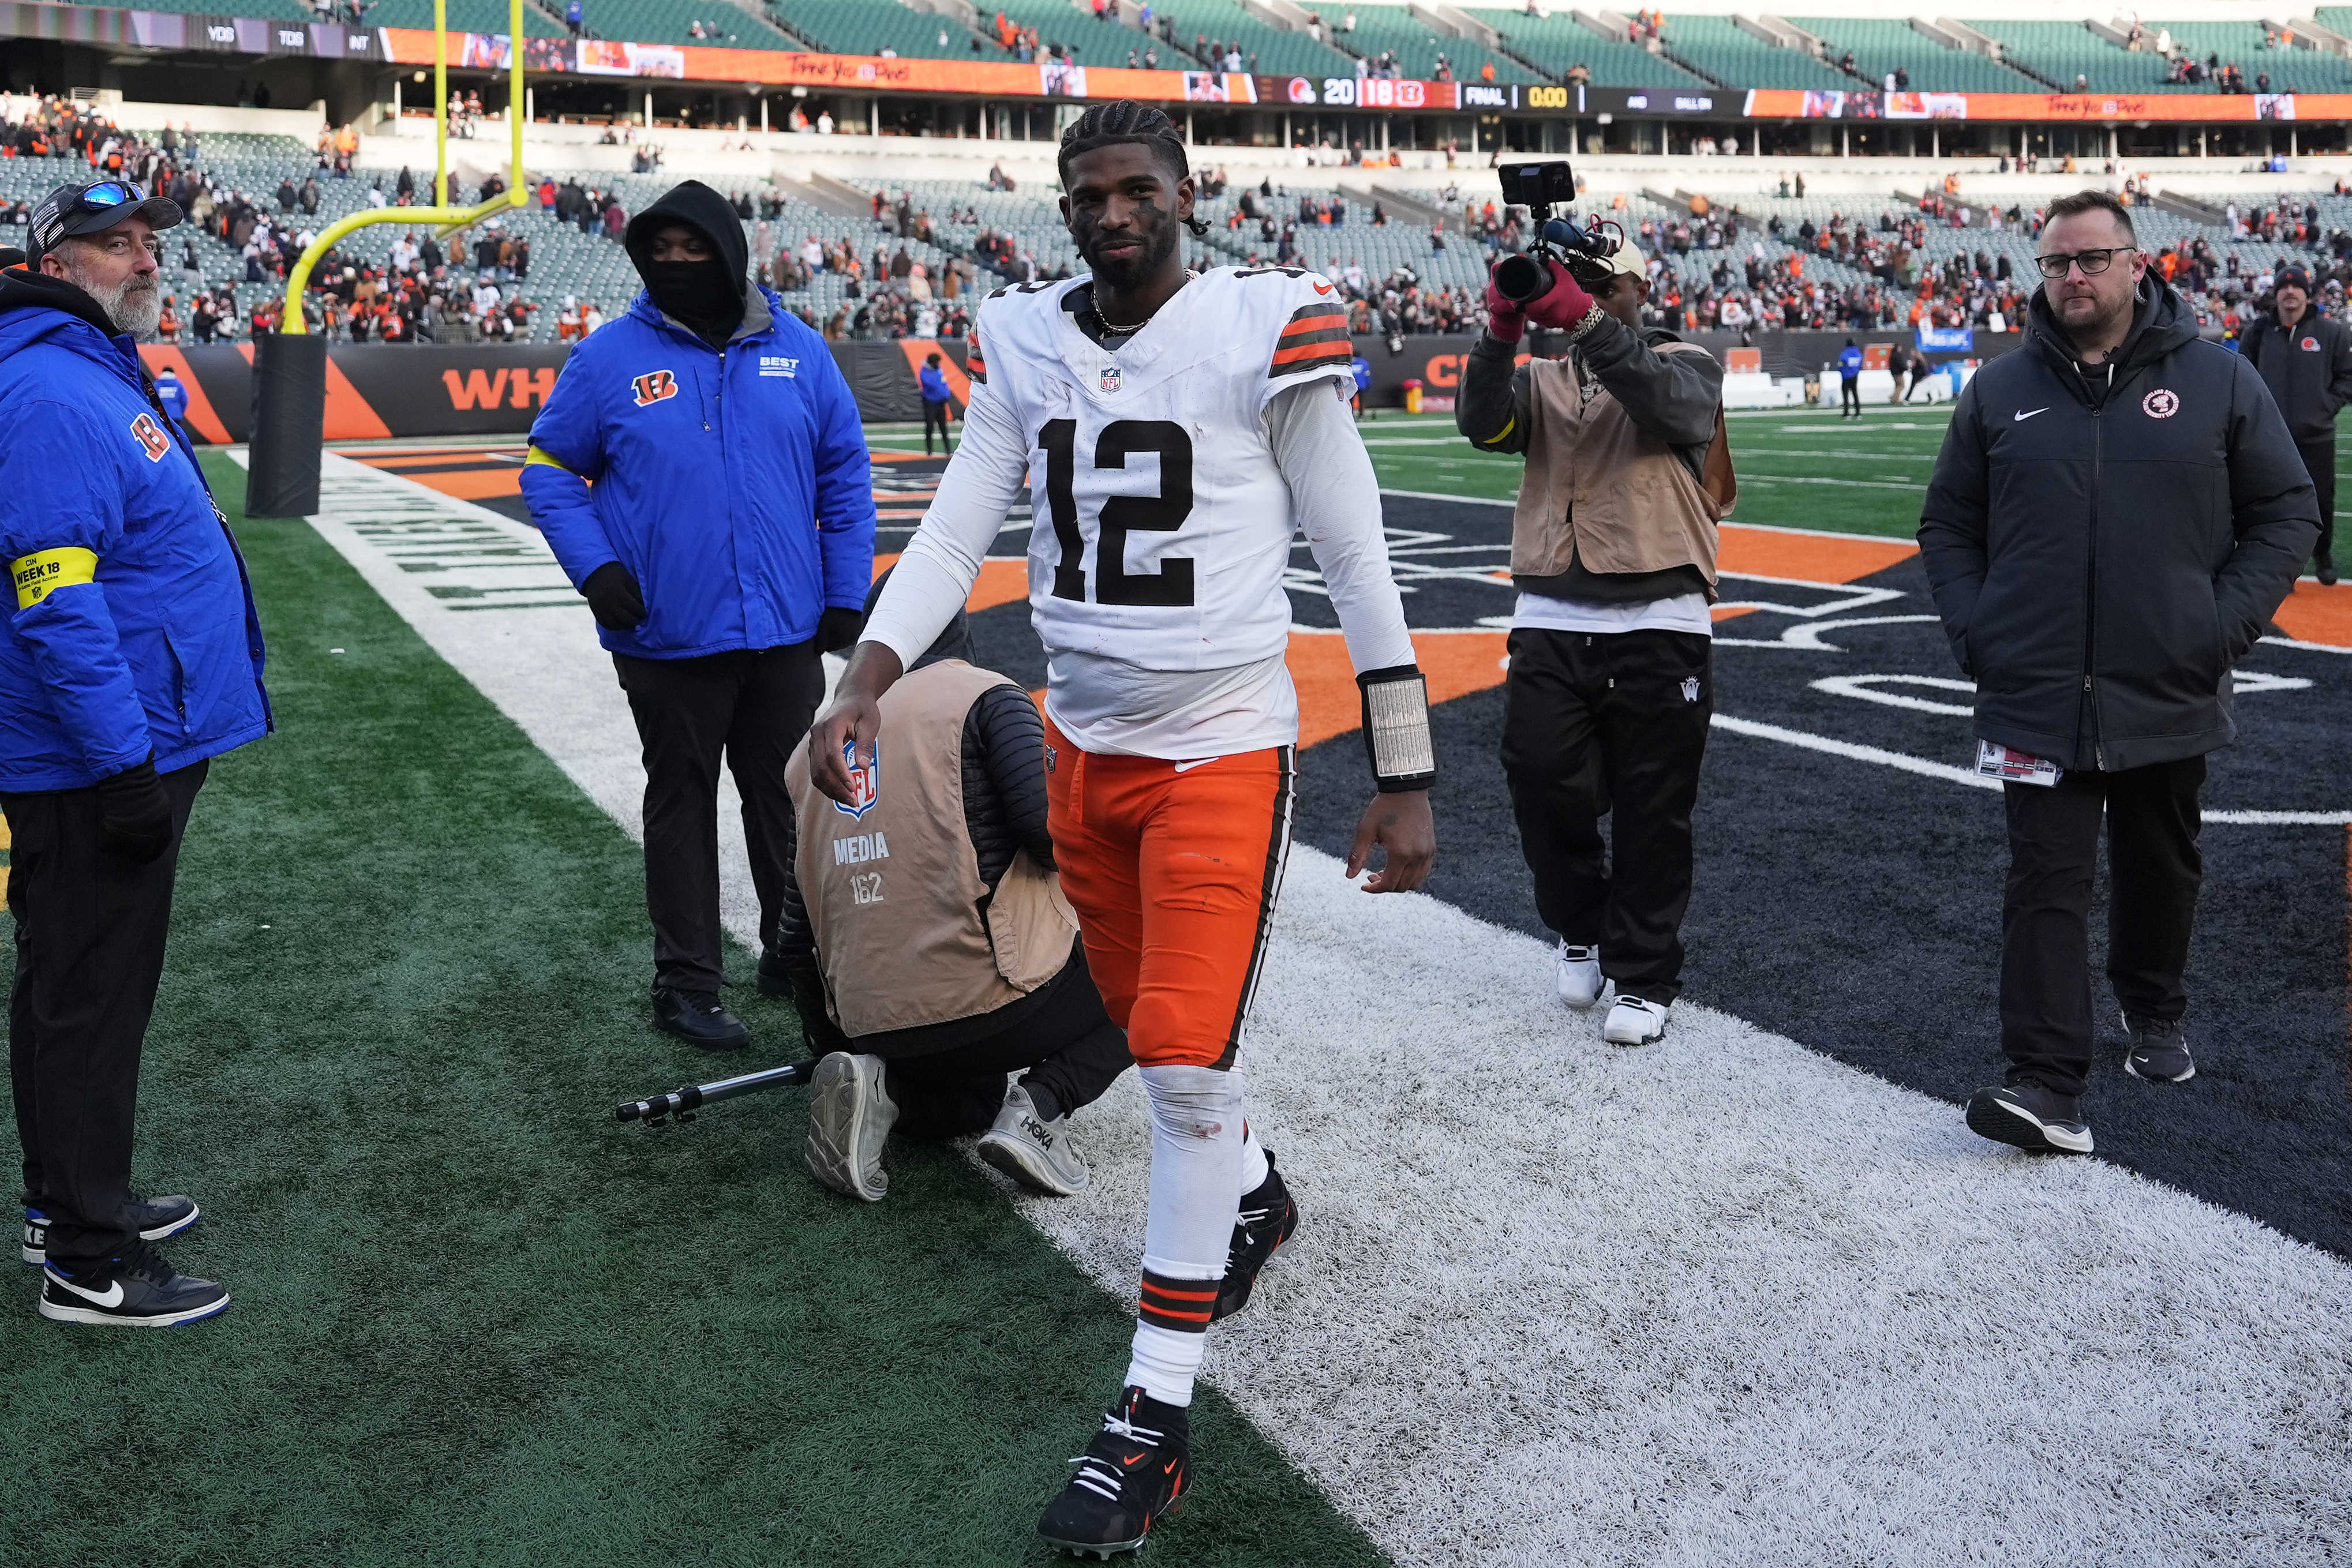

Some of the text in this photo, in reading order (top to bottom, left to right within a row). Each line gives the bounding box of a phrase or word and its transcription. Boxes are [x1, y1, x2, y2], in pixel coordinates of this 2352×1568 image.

[208, 25, 235, 42] YDS
[279, 30, 304, 47] TDS
[349, 35, 369, 51] INT
[1324, 78, 1355, 104] 20
[1366, 80, 1393, 105] 18
[1466, 87, 1507, 106] FINAL
[1530, 86, 1568, 108] 0:00
[759, 357, 800, 369] BEST
[442, 367, 555, 410] WH
[1102, 377, 1119, 389] NFL
[1038, 418, 1194, 606] 12
[25, 557, 38, 567] CIN
[16, 562, 60, 585] WEEK 18
[31, 579, 41, 587] Field
[852, 769, 875, 807] FL
[833, 831, 890, 866] MEDIA
[849, 872, 884, 905] 162
[1020, 1115, 1053, 1151] HOKA
[25, 1224, 45, 1246] KE
